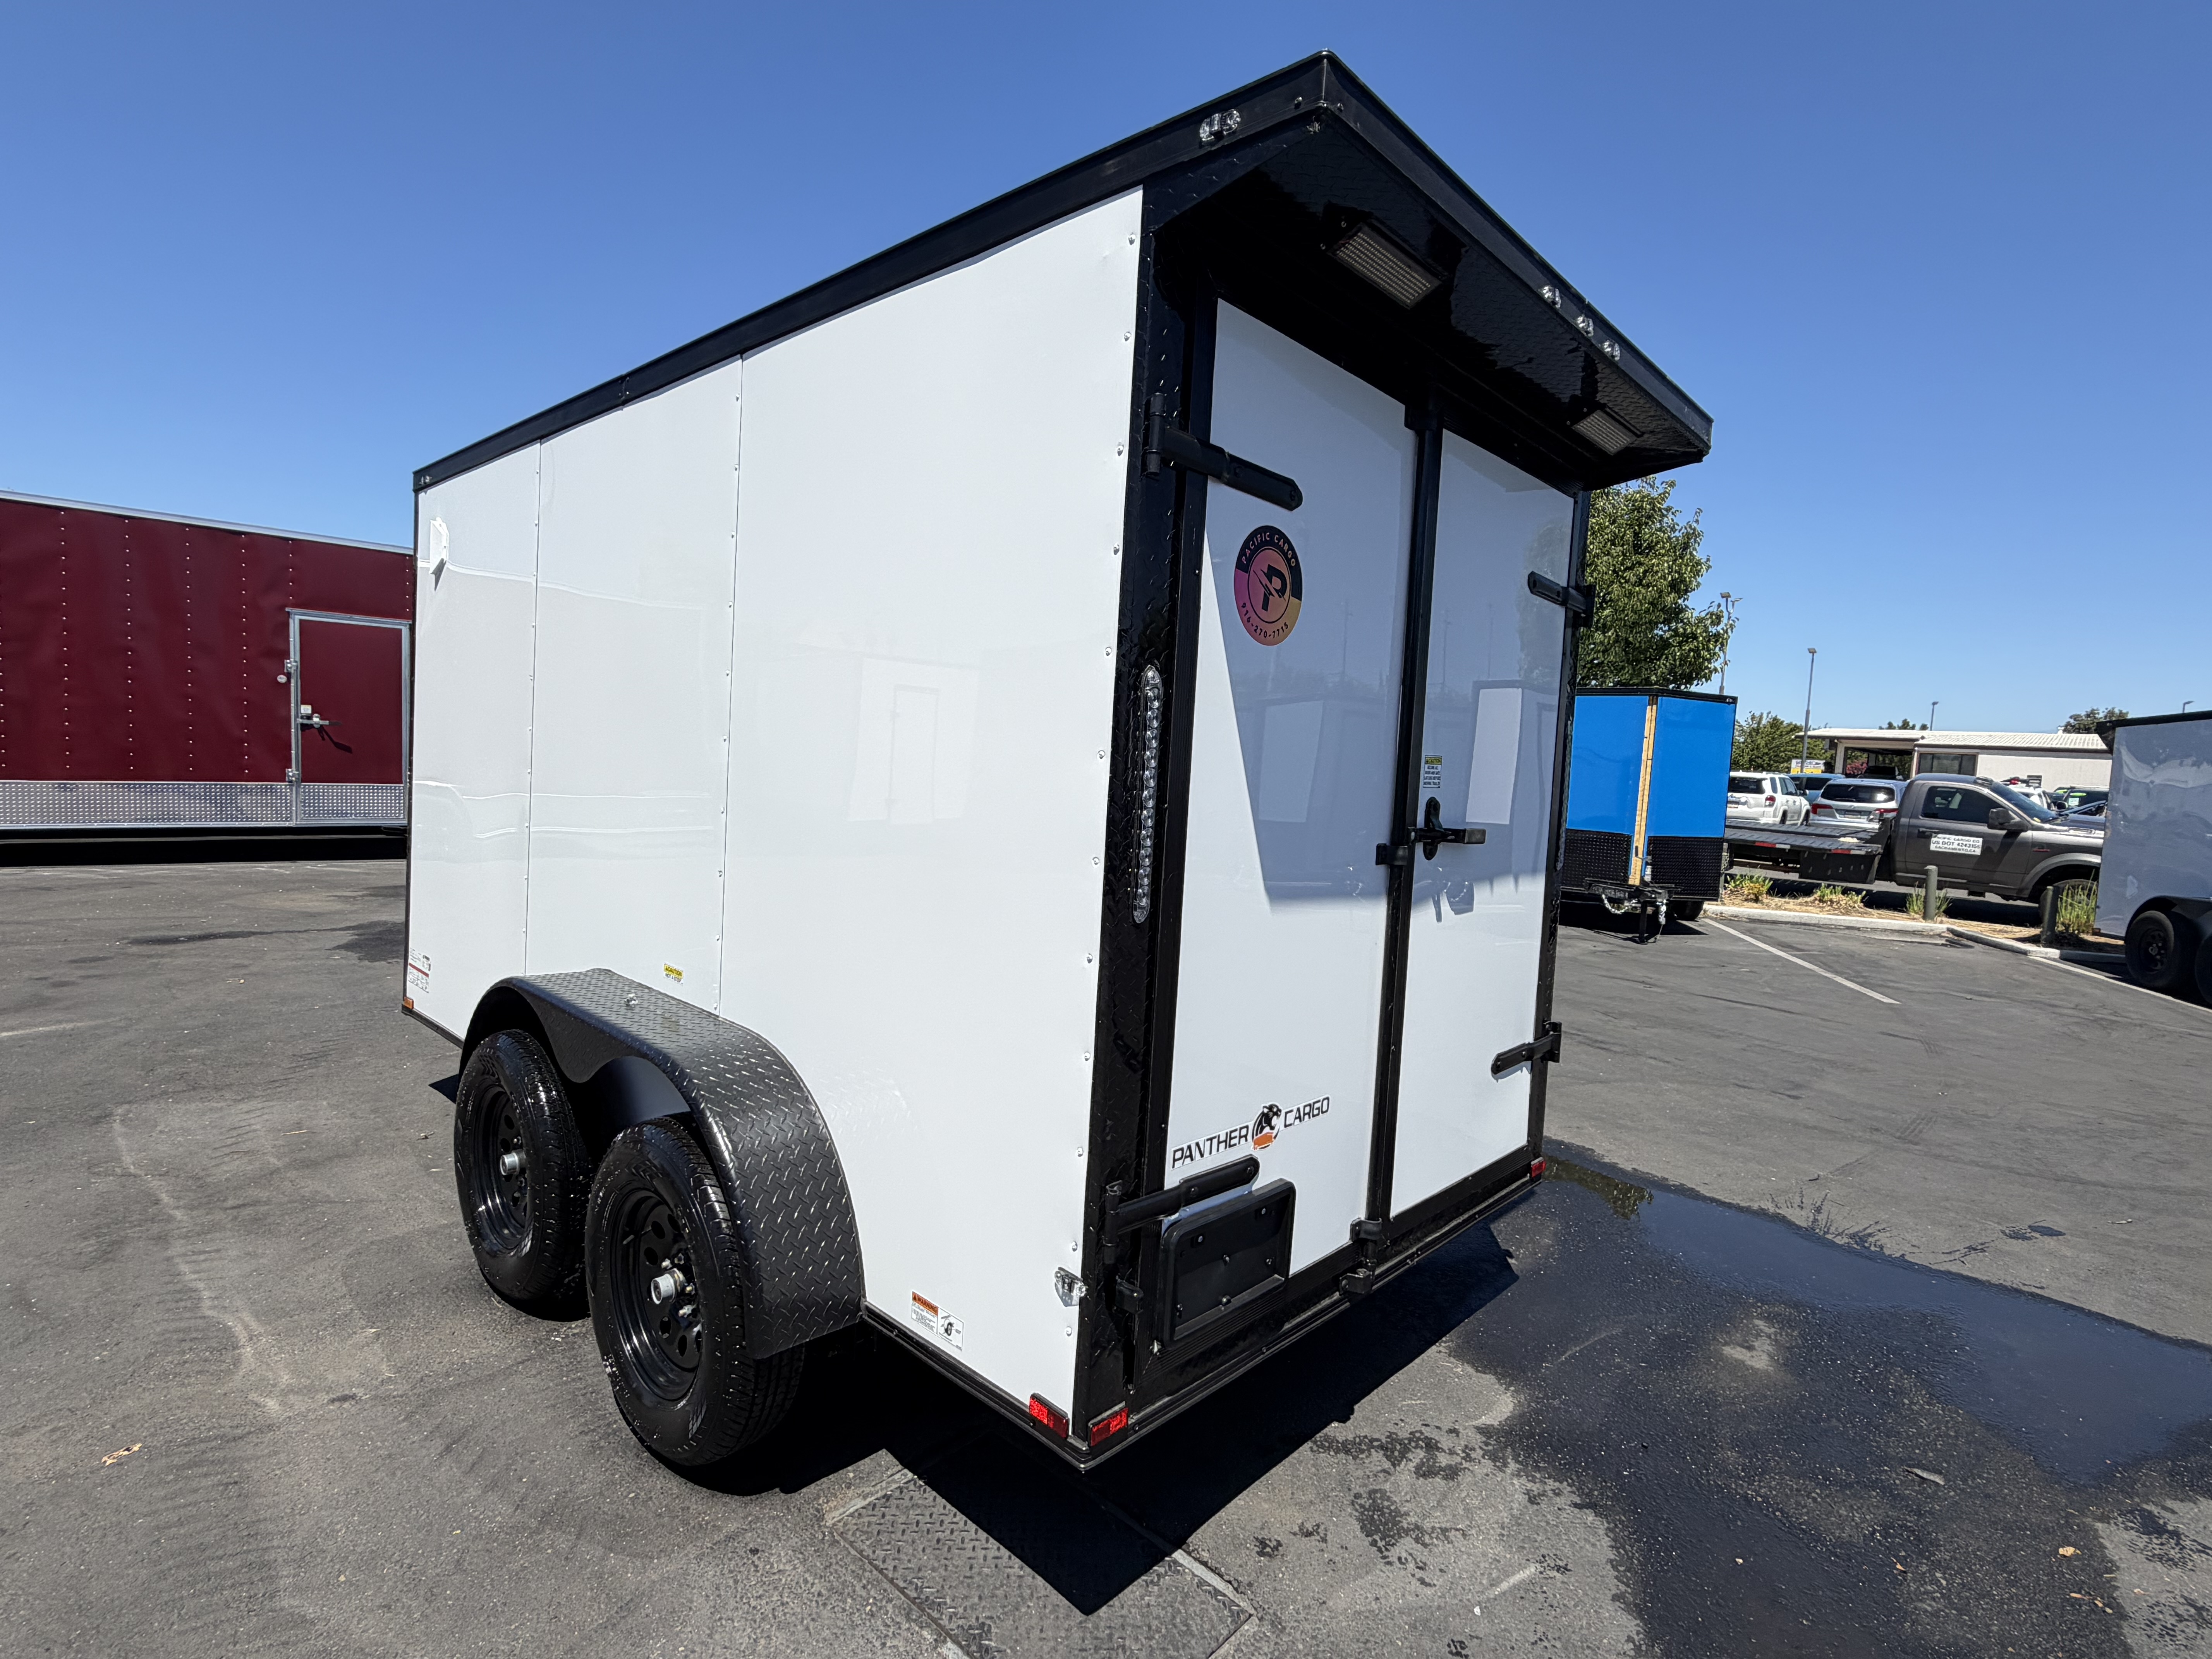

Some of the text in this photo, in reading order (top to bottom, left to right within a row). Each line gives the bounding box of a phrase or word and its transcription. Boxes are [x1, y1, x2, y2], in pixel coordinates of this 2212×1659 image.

[1242, 532, 1296, 567] PACIFIC CARGO
[1241, 603, 1288, 638] 916-270-7715
[1172, 1096, 1330, 1169] PANTHER CARGO
[917, 1294, 938, 1313] WARNING
